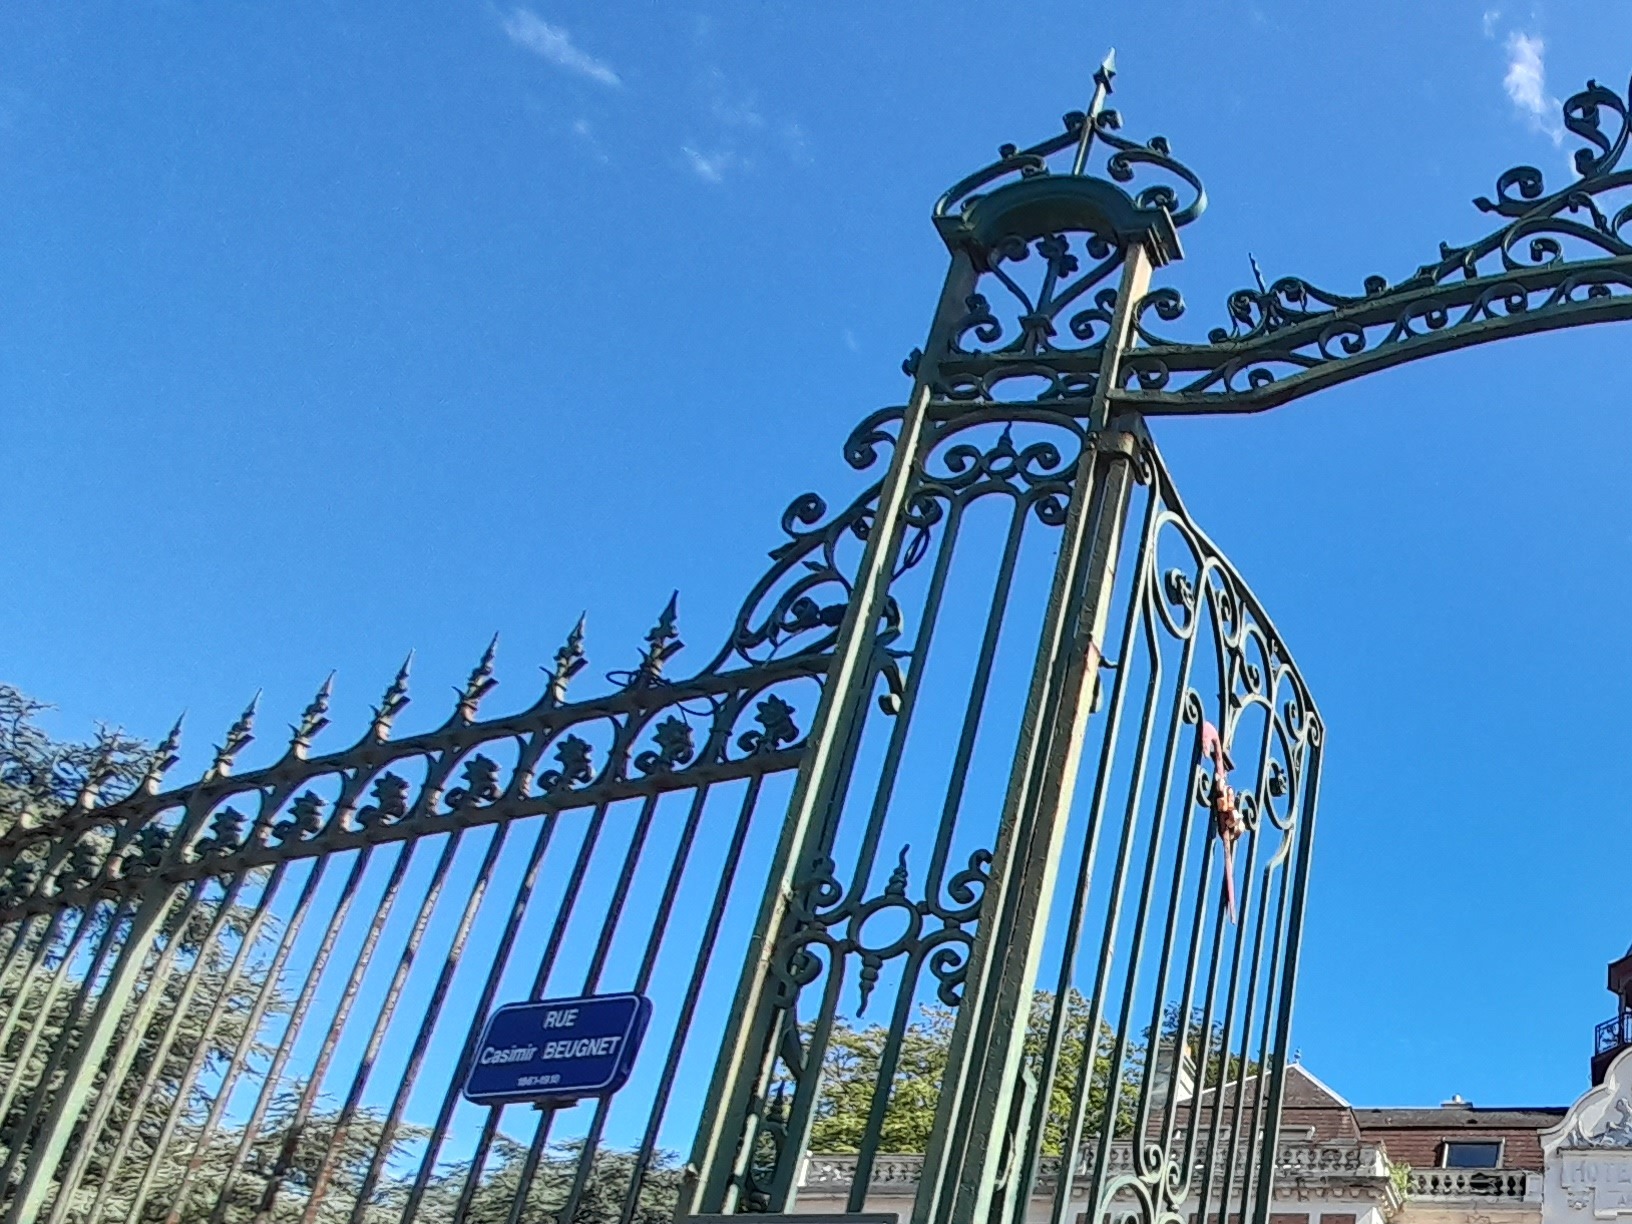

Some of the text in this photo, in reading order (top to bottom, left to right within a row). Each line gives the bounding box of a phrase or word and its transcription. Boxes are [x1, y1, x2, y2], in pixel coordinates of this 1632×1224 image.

[542, 1008, 579, 1029] RUE
[480, 1036, 622, 1065] Casimir BEUGNET
